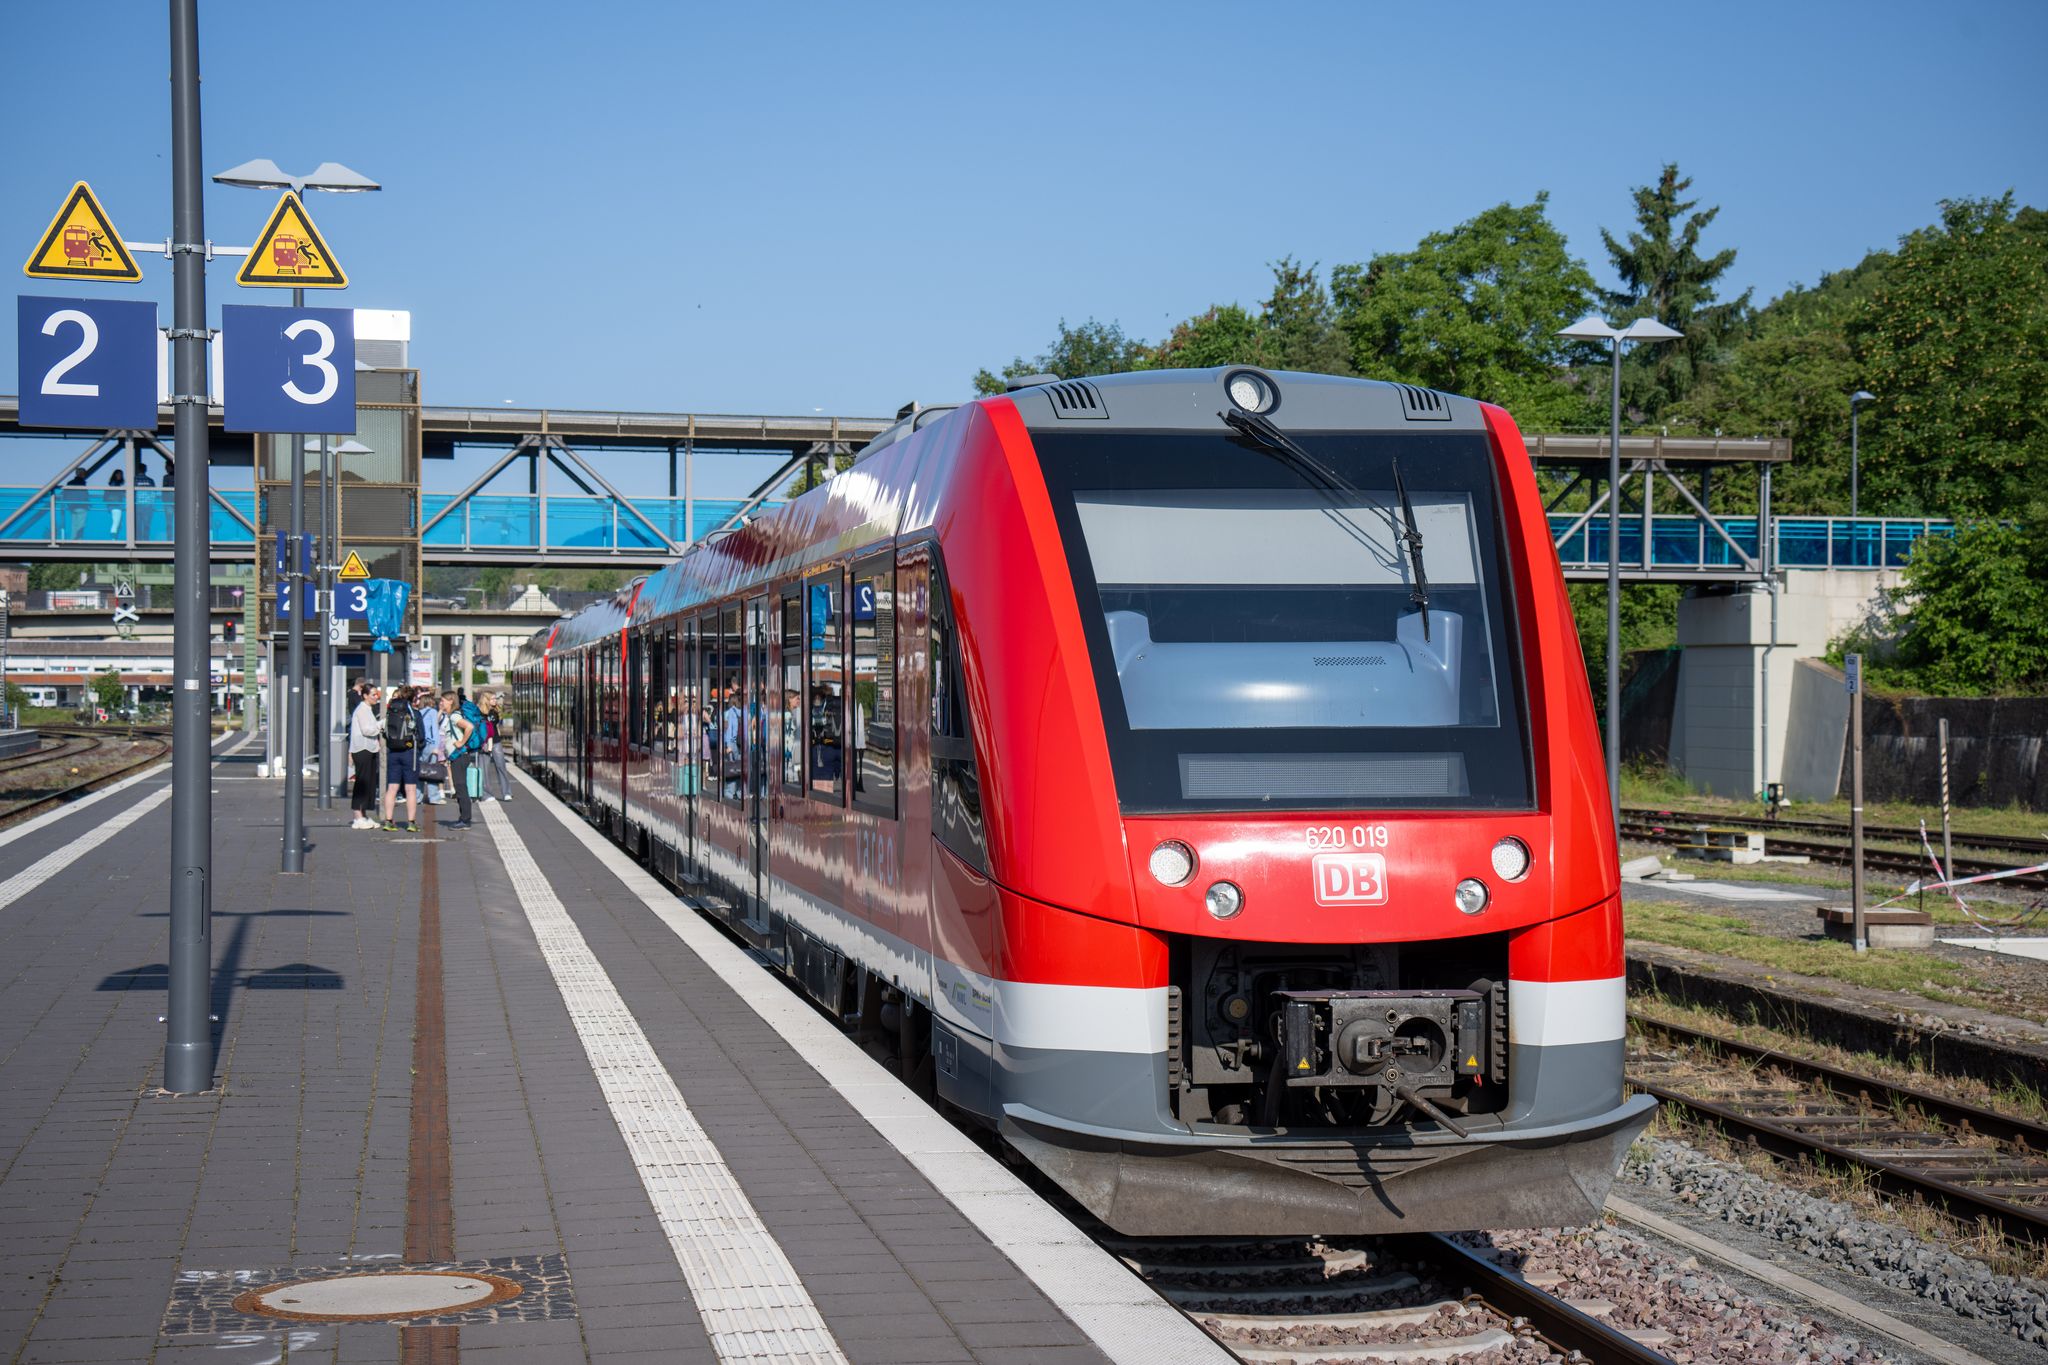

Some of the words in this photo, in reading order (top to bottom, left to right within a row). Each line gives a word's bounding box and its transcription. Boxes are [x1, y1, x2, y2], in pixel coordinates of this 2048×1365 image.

[41, 310, 99, 396] 2
[282, 319, 339, 405] 3
[350, 586, 367, 611] 3
[855, 827, 894, 886] vareo
[1305, 826, 1346, 848] 620
[1352, 825, 1388, 848] 019
[1323, 864, 1378, 896] DB
